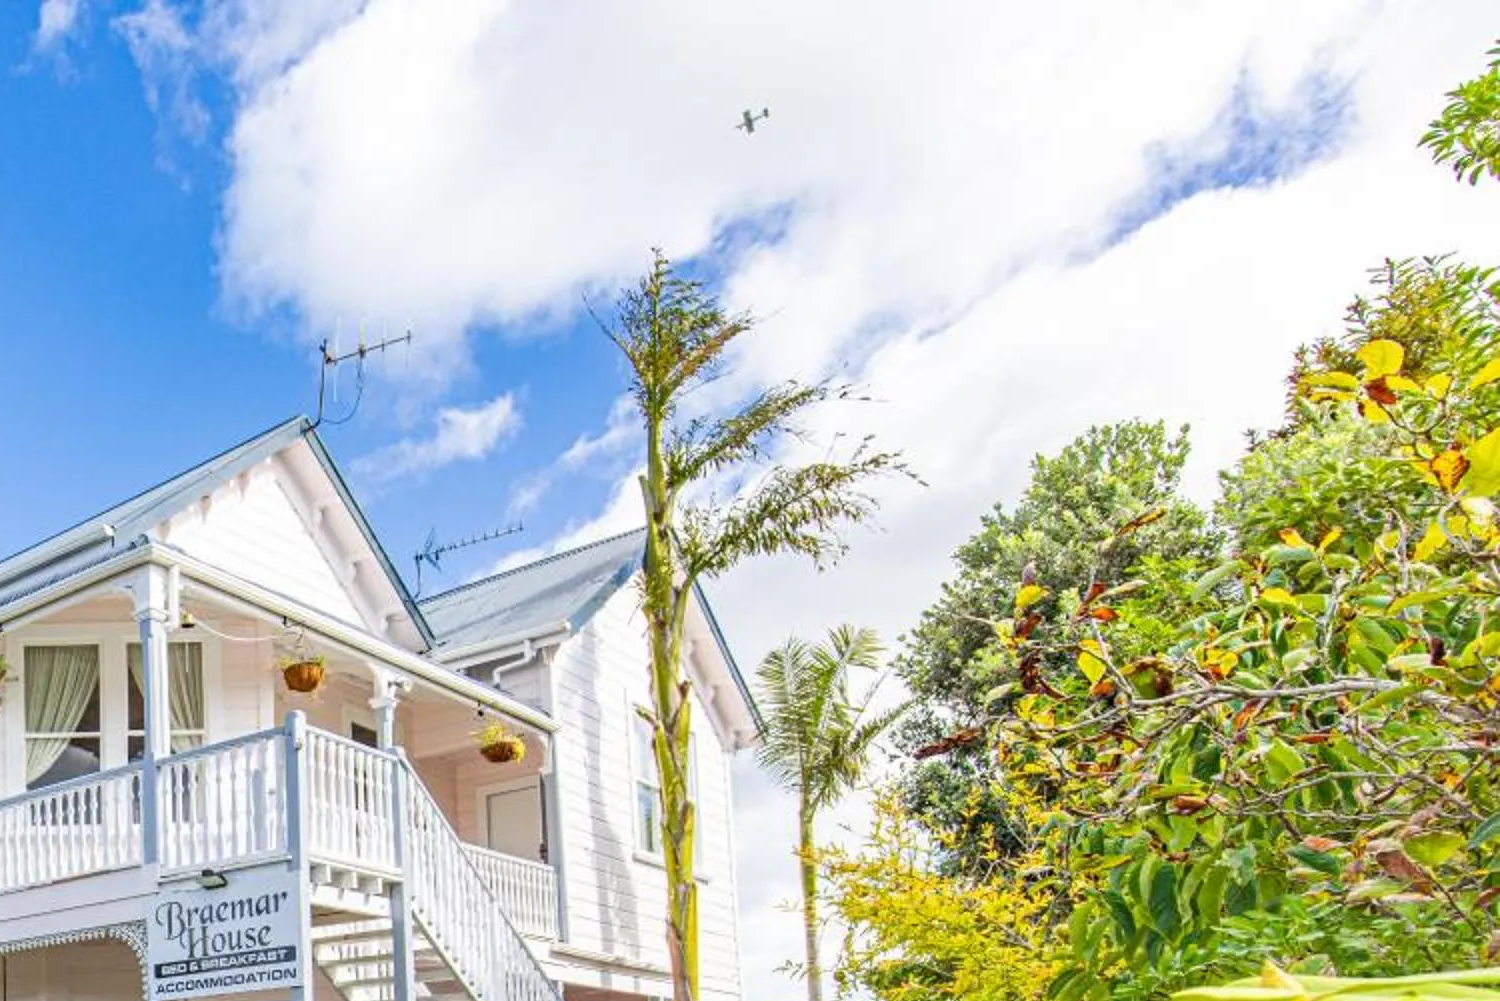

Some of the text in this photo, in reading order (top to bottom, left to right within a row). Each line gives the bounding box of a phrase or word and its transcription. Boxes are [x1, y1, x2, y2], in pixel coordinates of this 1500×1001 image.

[155, 891, 288, 940] Braemar
[179, 925, 273, 959] House
[161, 949, 288, 976] BED & BREAKFAST
[156, 968, 297, 994] ACCOMMODATION
